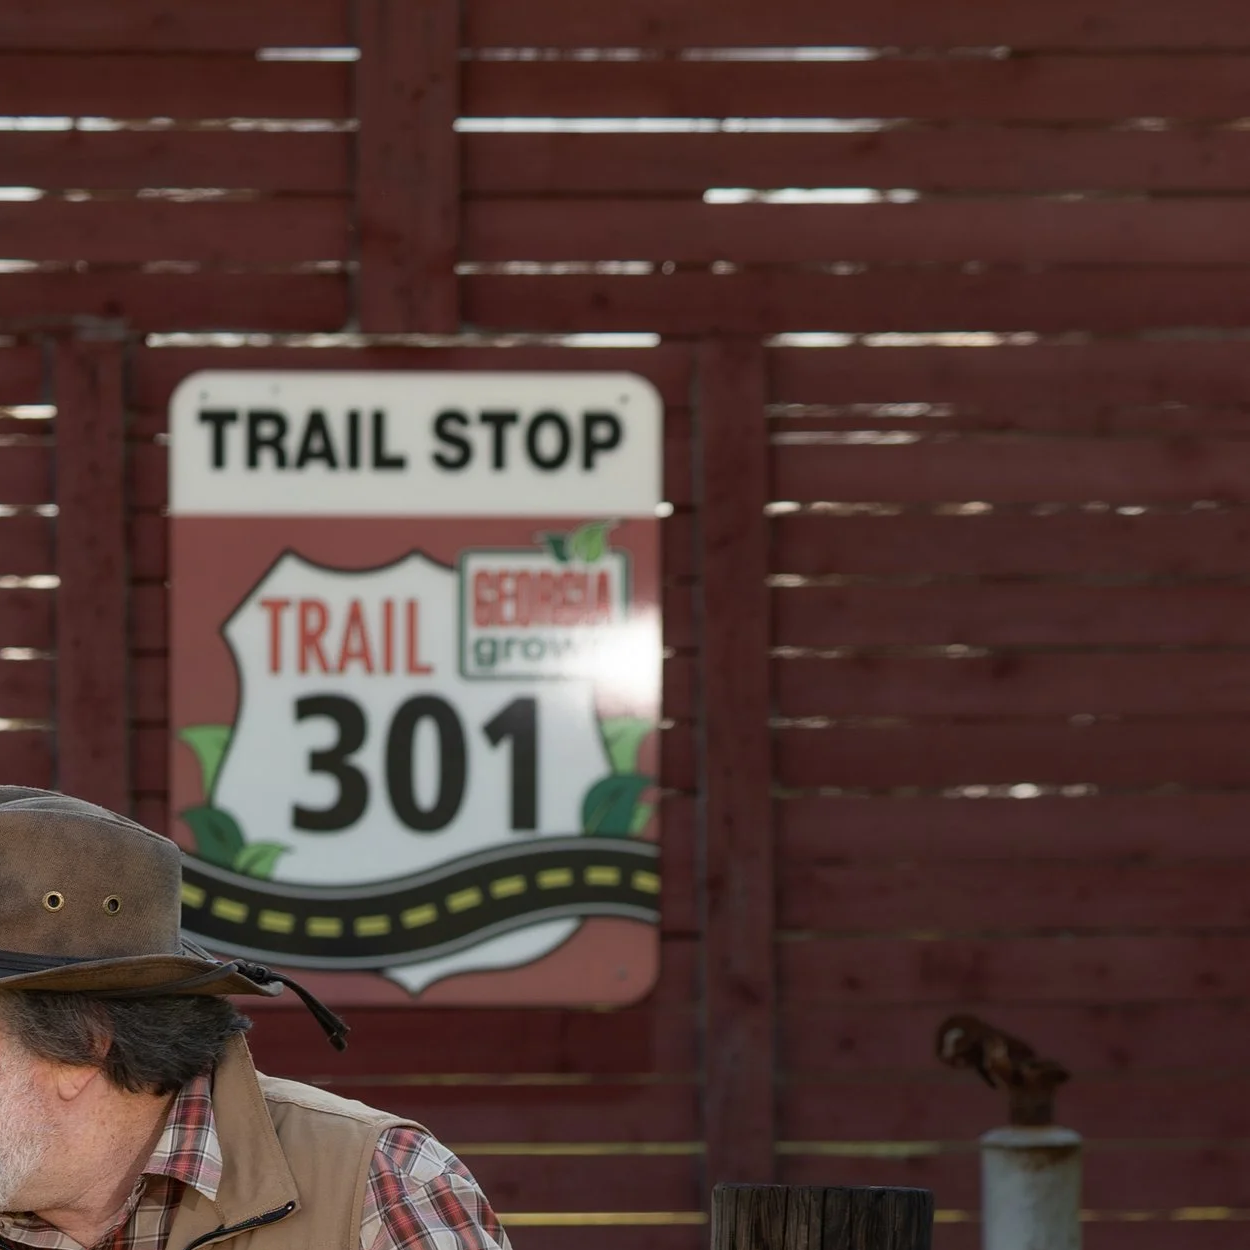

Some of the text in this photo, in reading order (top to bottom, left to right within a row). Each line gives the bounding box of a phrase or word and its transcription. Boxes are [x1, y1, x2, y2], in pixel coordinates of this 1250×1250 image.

[199, 408, 623, 472] TRAIL STOP
[472, 568, 612, 628] GEORGIA
[260, 598, 434, 675] TRAIL
[291, 693, 538, 834] 301
